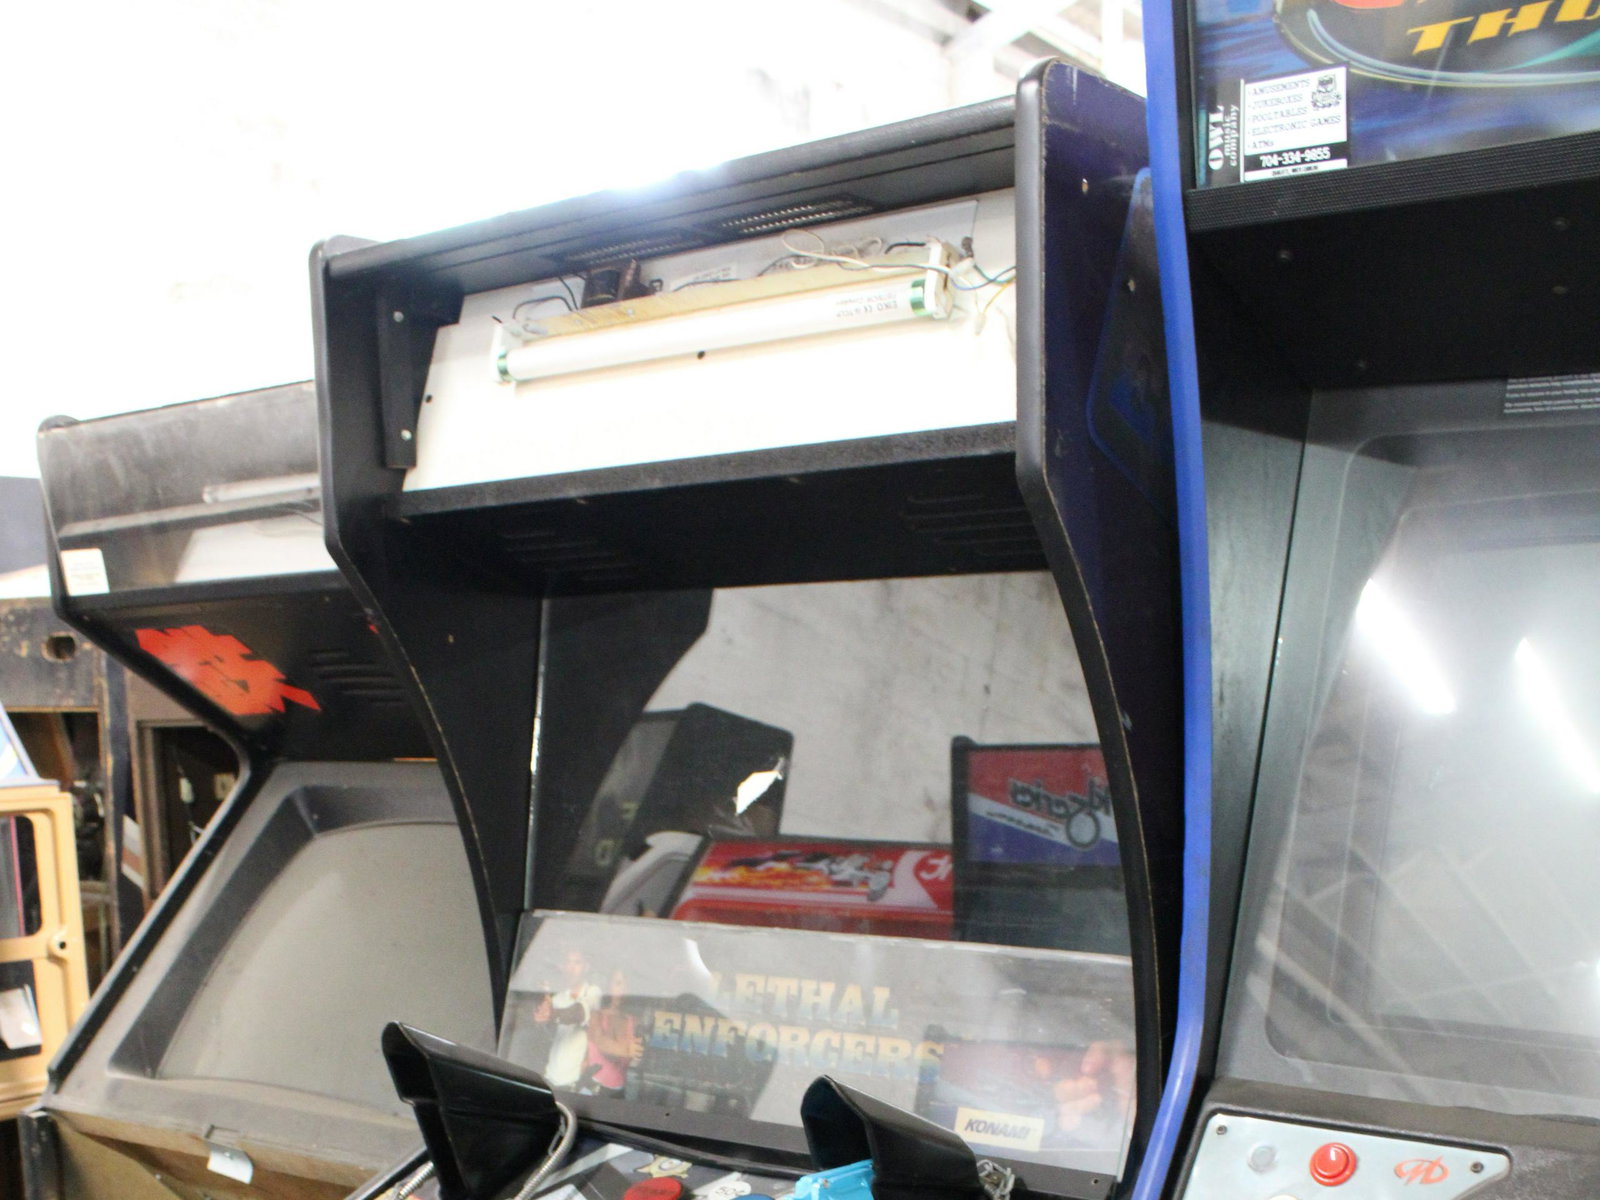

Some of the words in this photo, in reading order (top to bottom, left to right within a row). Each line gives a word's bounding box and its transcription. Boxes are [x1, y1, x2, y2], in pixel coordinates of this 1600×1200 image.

[1252, 79, 1311, 95] AMUSEMENTS
[1252, 94, 1304, 109] JUKEBOXES
[1208, 104, 1225, 171] OWL
[1222, 114, 1232, 156] music
[1229, 104, 1240, 167] company
[1251, 120, 1308, 136] ELECTRONIC
[1310, 115, 1342, 128] GAMES
[708, 971, 900, 1031] LETHAL
[649, 1010, 945, 1085] ENFORCERS
[964, 1118, 1031, 1140] KONAMI
